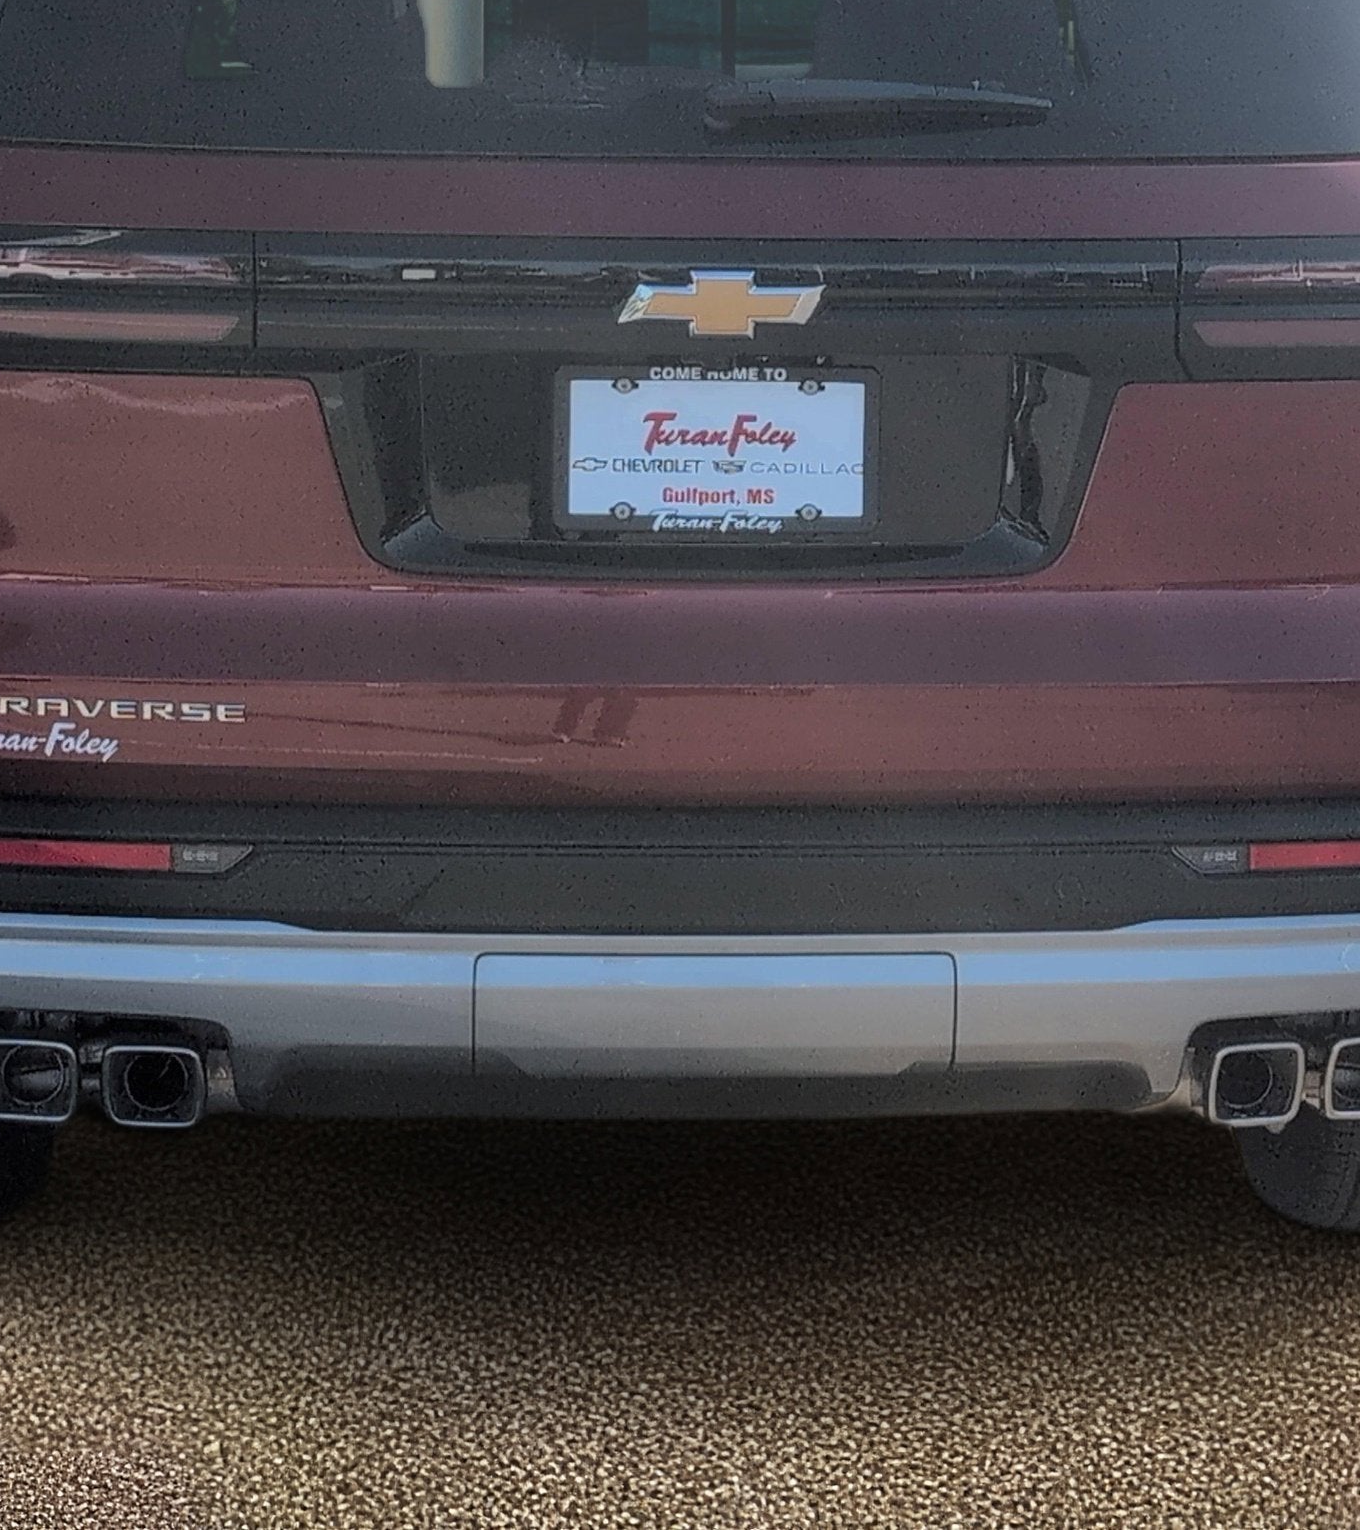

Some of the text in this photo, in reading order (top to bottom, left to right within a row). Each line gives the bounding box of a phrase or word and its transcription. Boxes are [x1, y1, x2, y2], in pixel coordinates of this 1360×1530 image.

[649, 366, 702, 380] COME
[763, 368, 787, 381] TO
[611, 458, 864, 475] CHEVROLET CADILLAC
[662, 487, 775, 506] Gulfport, MS
